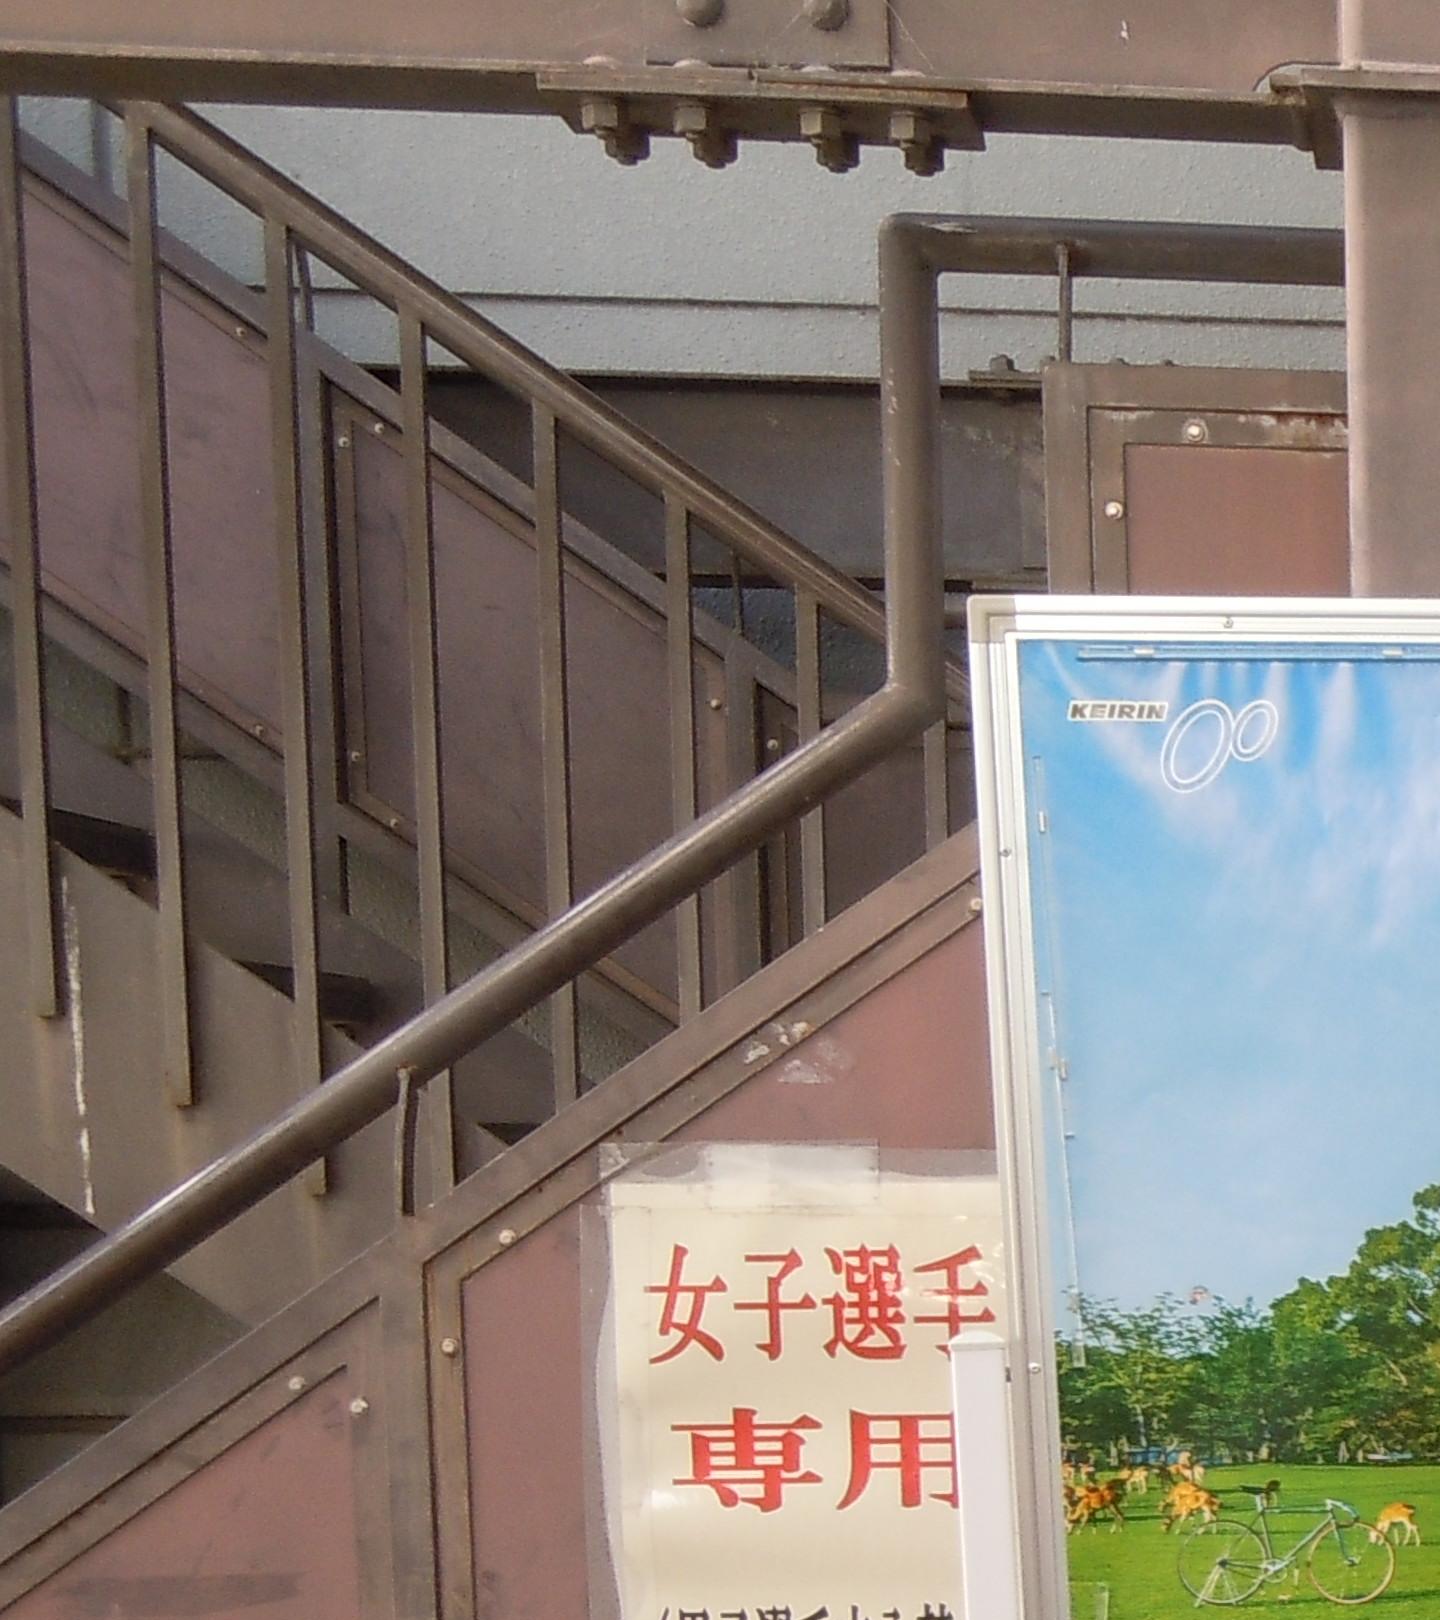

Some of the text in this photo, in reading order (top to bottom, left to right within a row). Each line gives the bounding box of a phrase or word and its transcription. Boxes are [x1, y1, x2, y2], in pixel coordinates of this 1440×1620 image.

[1069, 701, 1167, 721] KEIRIN
[644, 1243, 996, 1366] 女子選手
[670, 1406, 961, 1514] 専用
